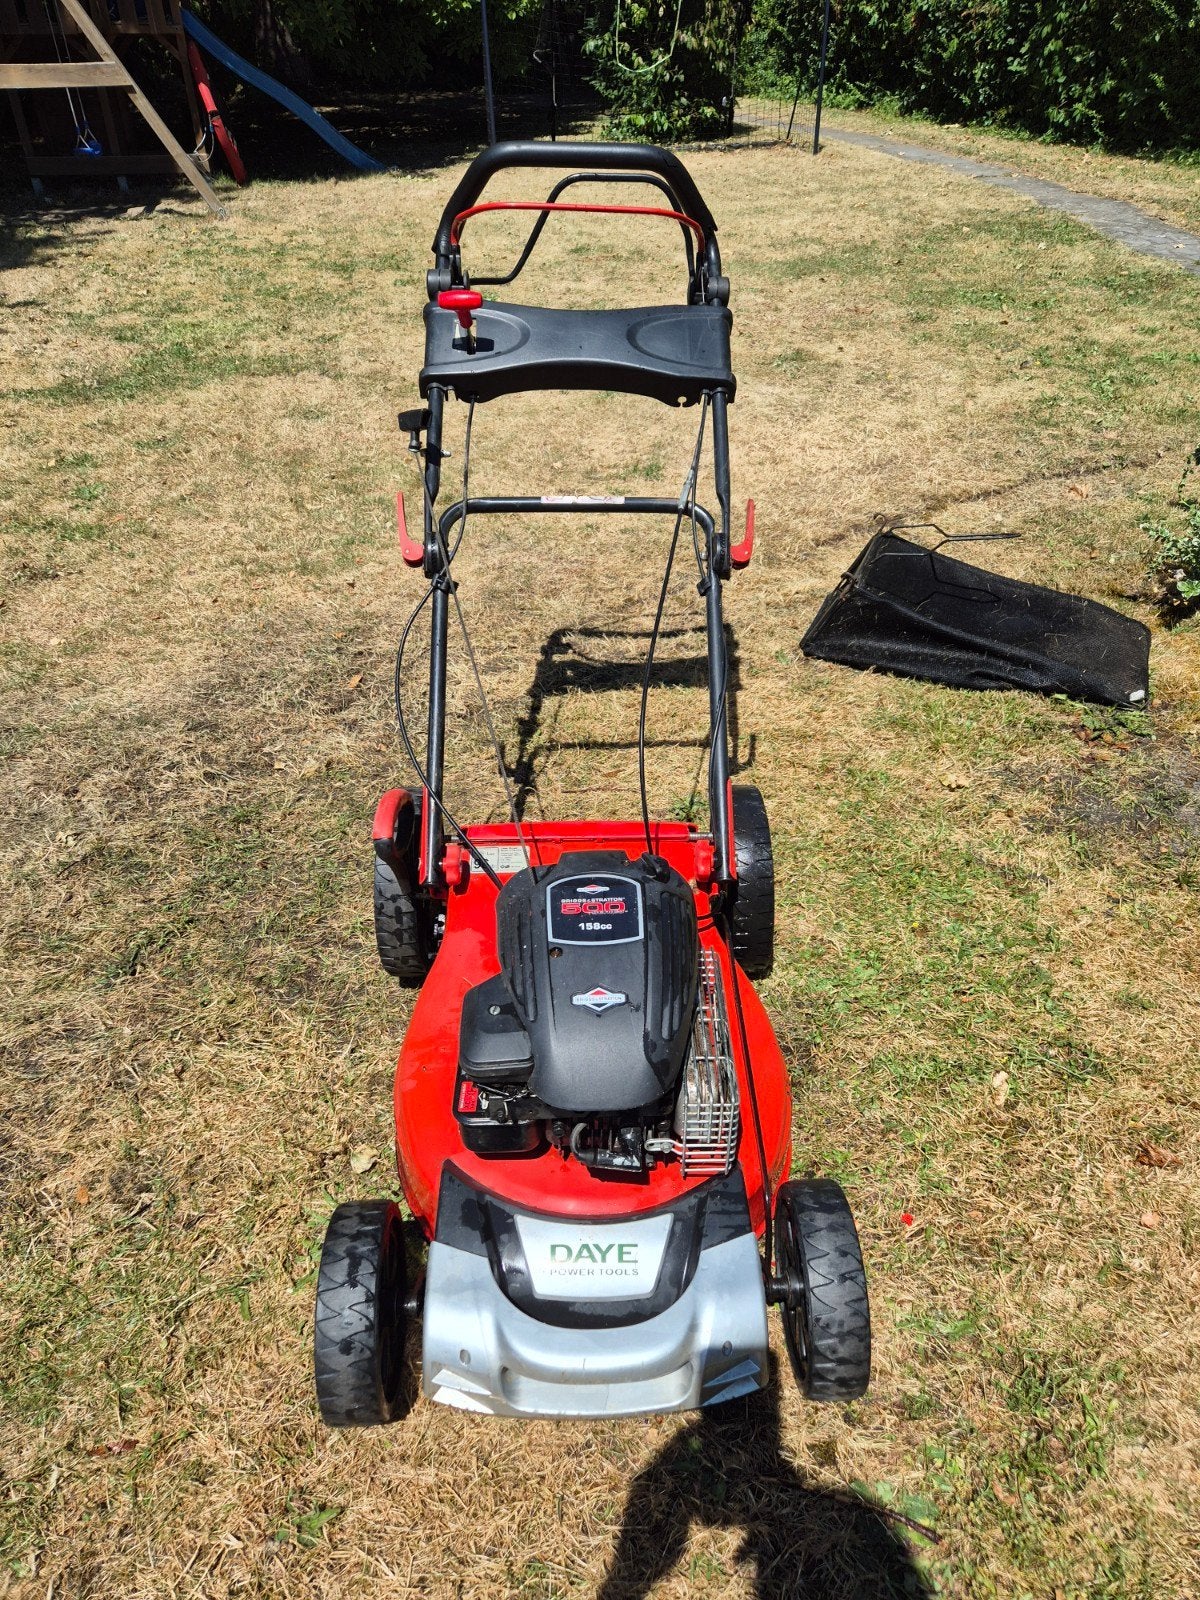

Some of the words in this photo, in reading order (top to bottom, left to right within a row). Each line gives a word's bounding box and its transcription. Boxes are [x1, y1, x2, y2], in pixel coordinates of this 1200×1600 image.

[561, 902, 625, 914] 500
[579, 922, 612, 930] 158cc
[550, 1243, 638, 1263] DAYE
[600, 1268, 639, 1276] TOOLS
